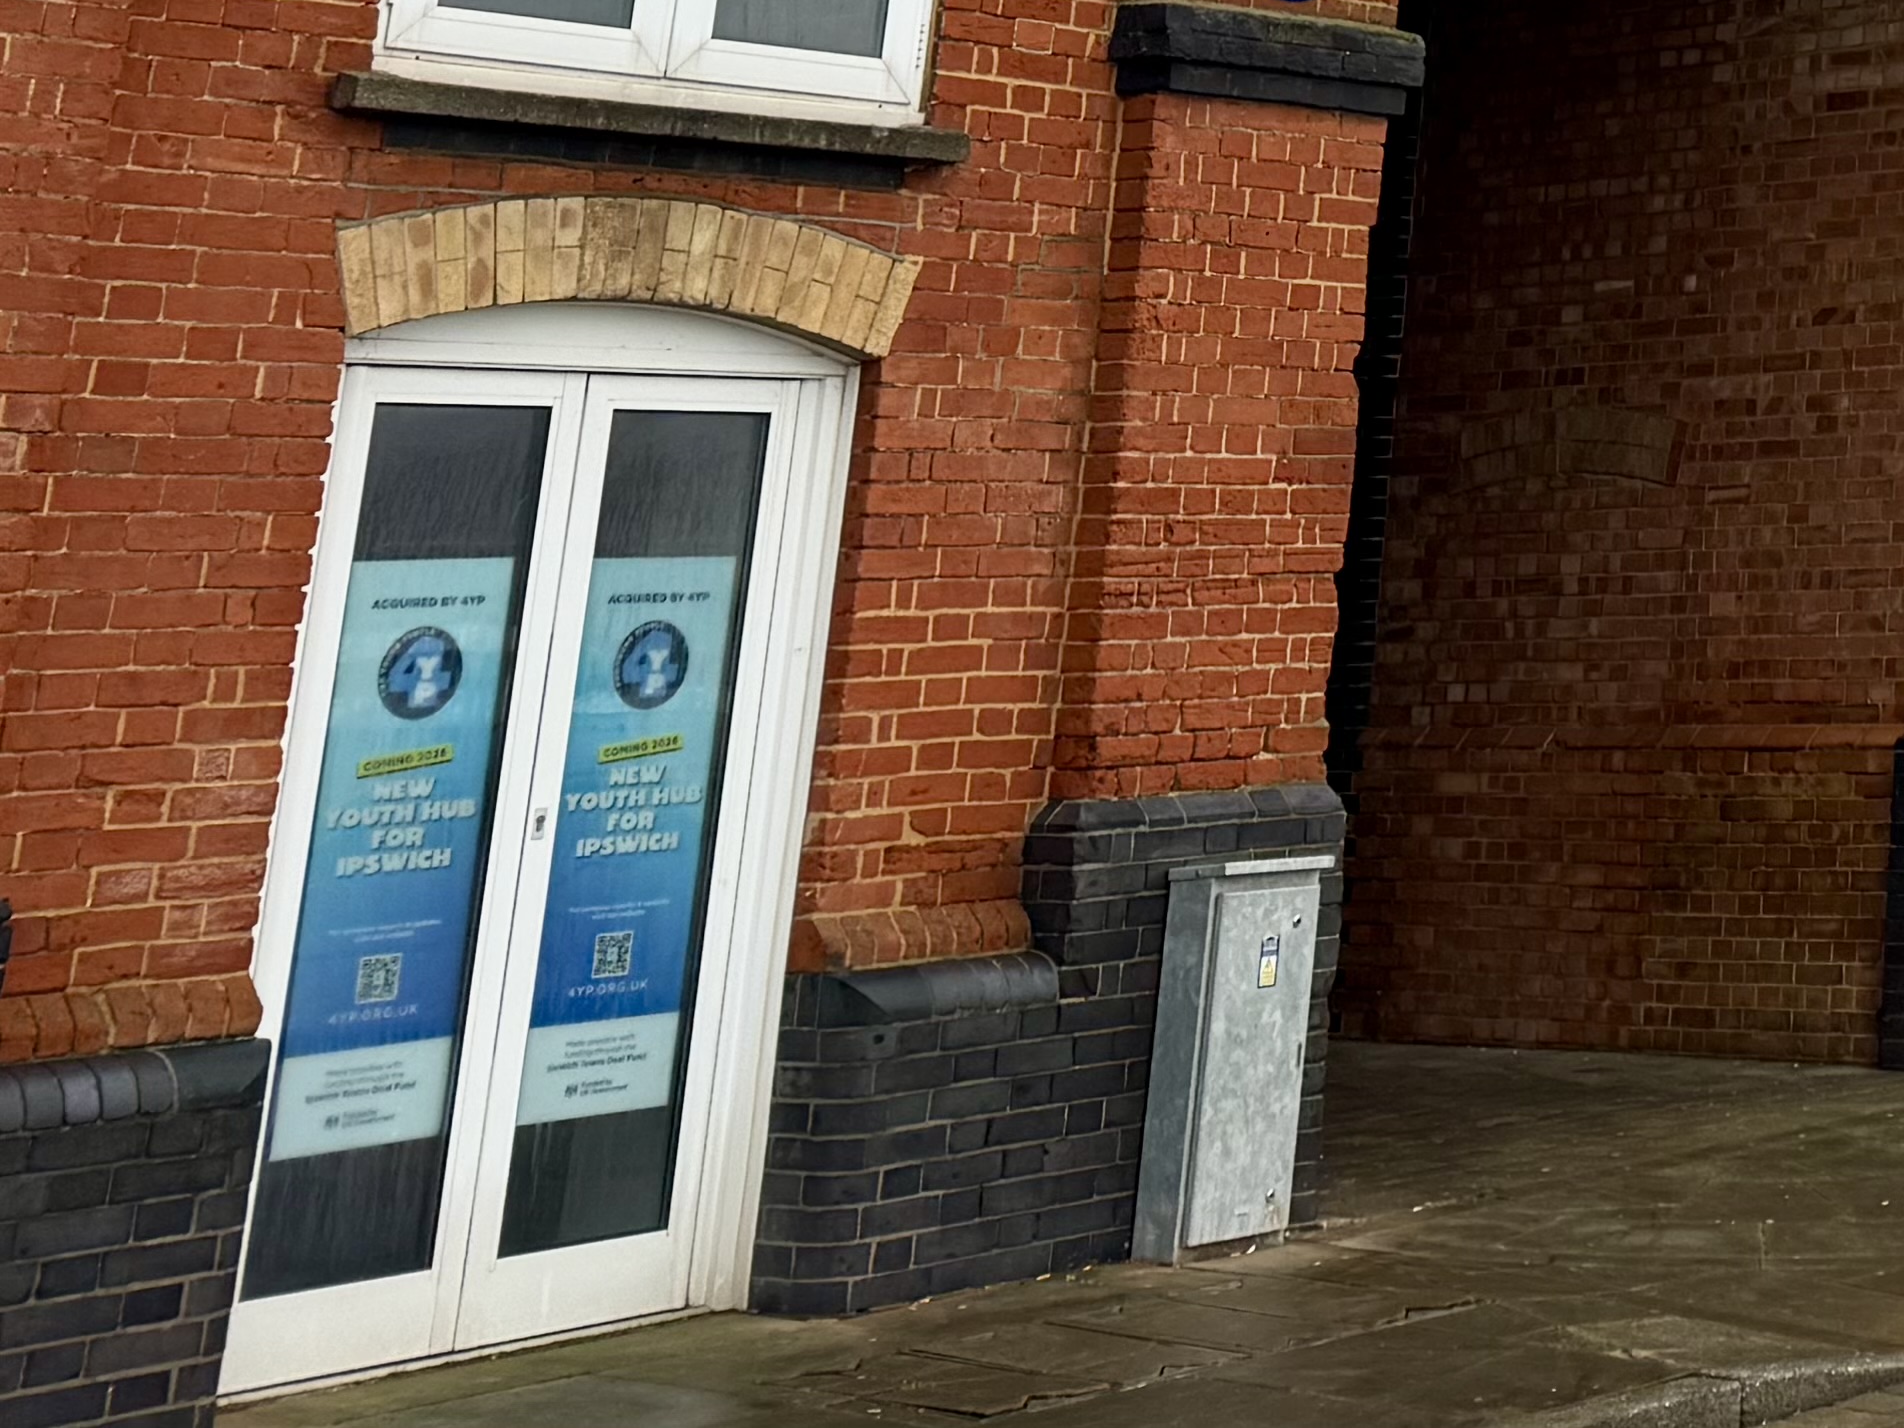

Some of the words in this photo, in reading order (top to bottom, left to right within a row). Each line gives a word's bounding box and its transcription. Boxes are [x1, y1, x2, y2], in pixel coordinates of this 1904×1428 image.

[371, 597, 438, 610] ACQUIRED
[440, 596, 458, 607] BY
[460, 595, 486, 607] 4YP
[608, 593, 667, 604] ACQUIRED
[670, 593, 684, 603] BY
[687, 592, 711, 602] 4YP
[604, 742, 648, 758] COMING
[652, 736, 679, 750] 2026
[363, 755, 414, 771] COMING
[610, 763, 667, 787] NEW
[373, 776, 436, 802] NEW
[565, 788, 646, 812] YOUTH
[652, 785, 703, 806] HUB
[327, 803, 416, 830] YOUTH
[421, 798, 476, 823] HUB
[606, 809, 655, 832] FOR
[371, 826, 426, 850] FOR
[575, 832, 680, 858] IPSWICH
[336, 847, 451, 878] IPSWICH
[568, 979, 649, 998] 4YP.ORG.UK
